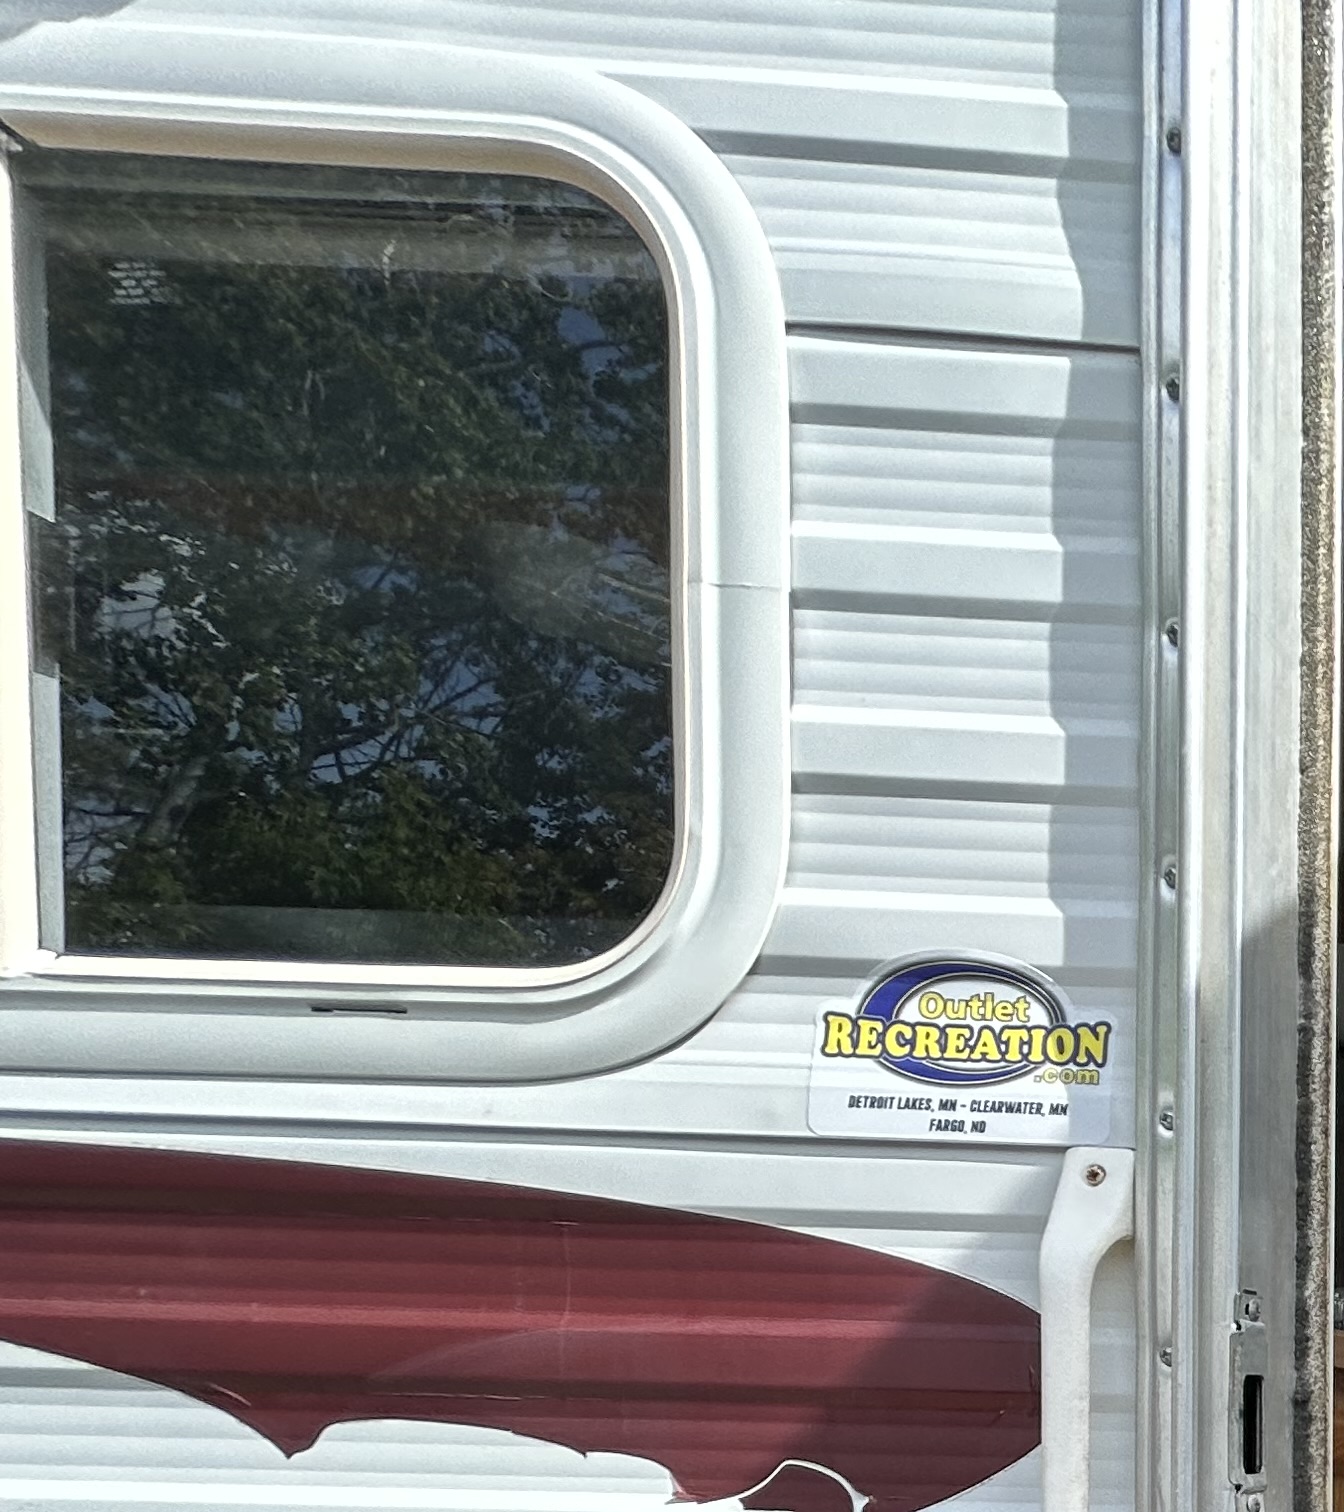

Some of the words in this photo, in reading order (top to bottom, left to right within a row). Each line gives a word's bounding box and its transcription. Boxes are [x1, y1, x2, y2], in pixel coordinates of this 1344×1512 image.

[918, 991, 1031, 1023] Outlet
[821, 1011, 1112, 1067] RECREATION
[1033, 1067, 1100, 1086] .com
[848, 1095, 895, 1109] DETROIT
[897, 1097, 934, 1112] LAKES,
[938, 1098, 957, 1112] MN
[970, 1100, 1045, 1117] CLEARWATER,
[1048, 1103, 1069, 1116] MN
[928, 1119, 967, 1134] FARGO,
[970, 1120, 987, 1133] ND
